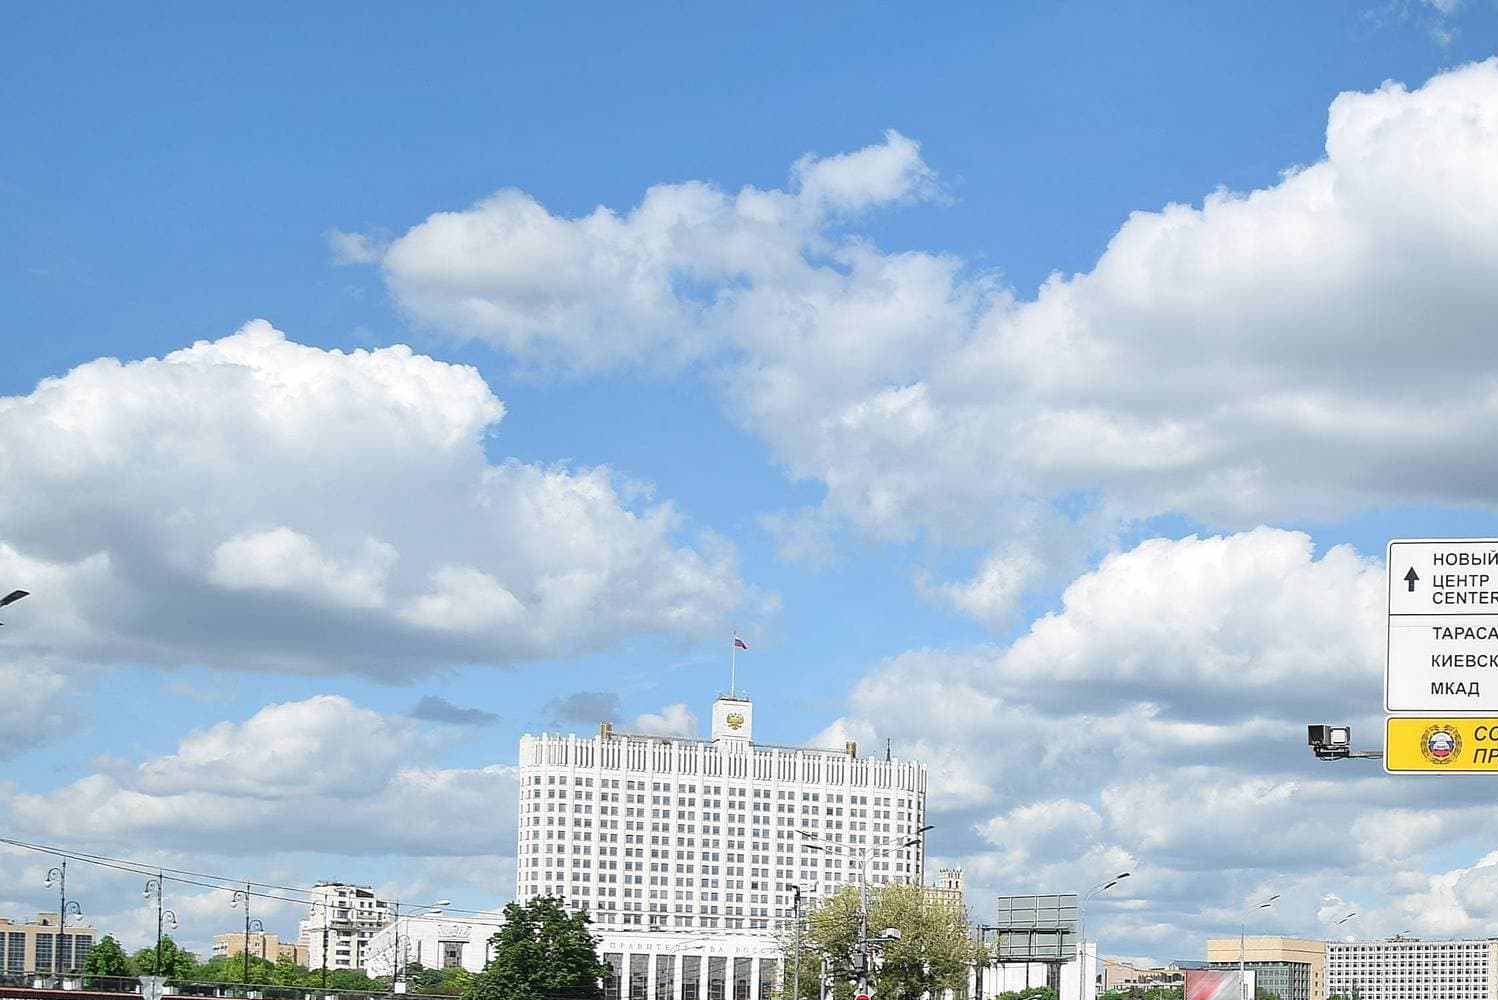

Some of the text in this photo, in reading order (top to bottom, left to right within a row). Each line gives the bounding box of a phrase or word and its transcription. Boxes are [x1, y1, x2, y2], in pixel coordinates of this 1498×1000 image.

[1433, 550, 1498, 566] НОВЫЙ
[1433, 574, 1490, 589] ЦЕНТР
[1433, 626, 1498, 640] ТАРАСА
[1431, 681, 1480, 697] МКАД
